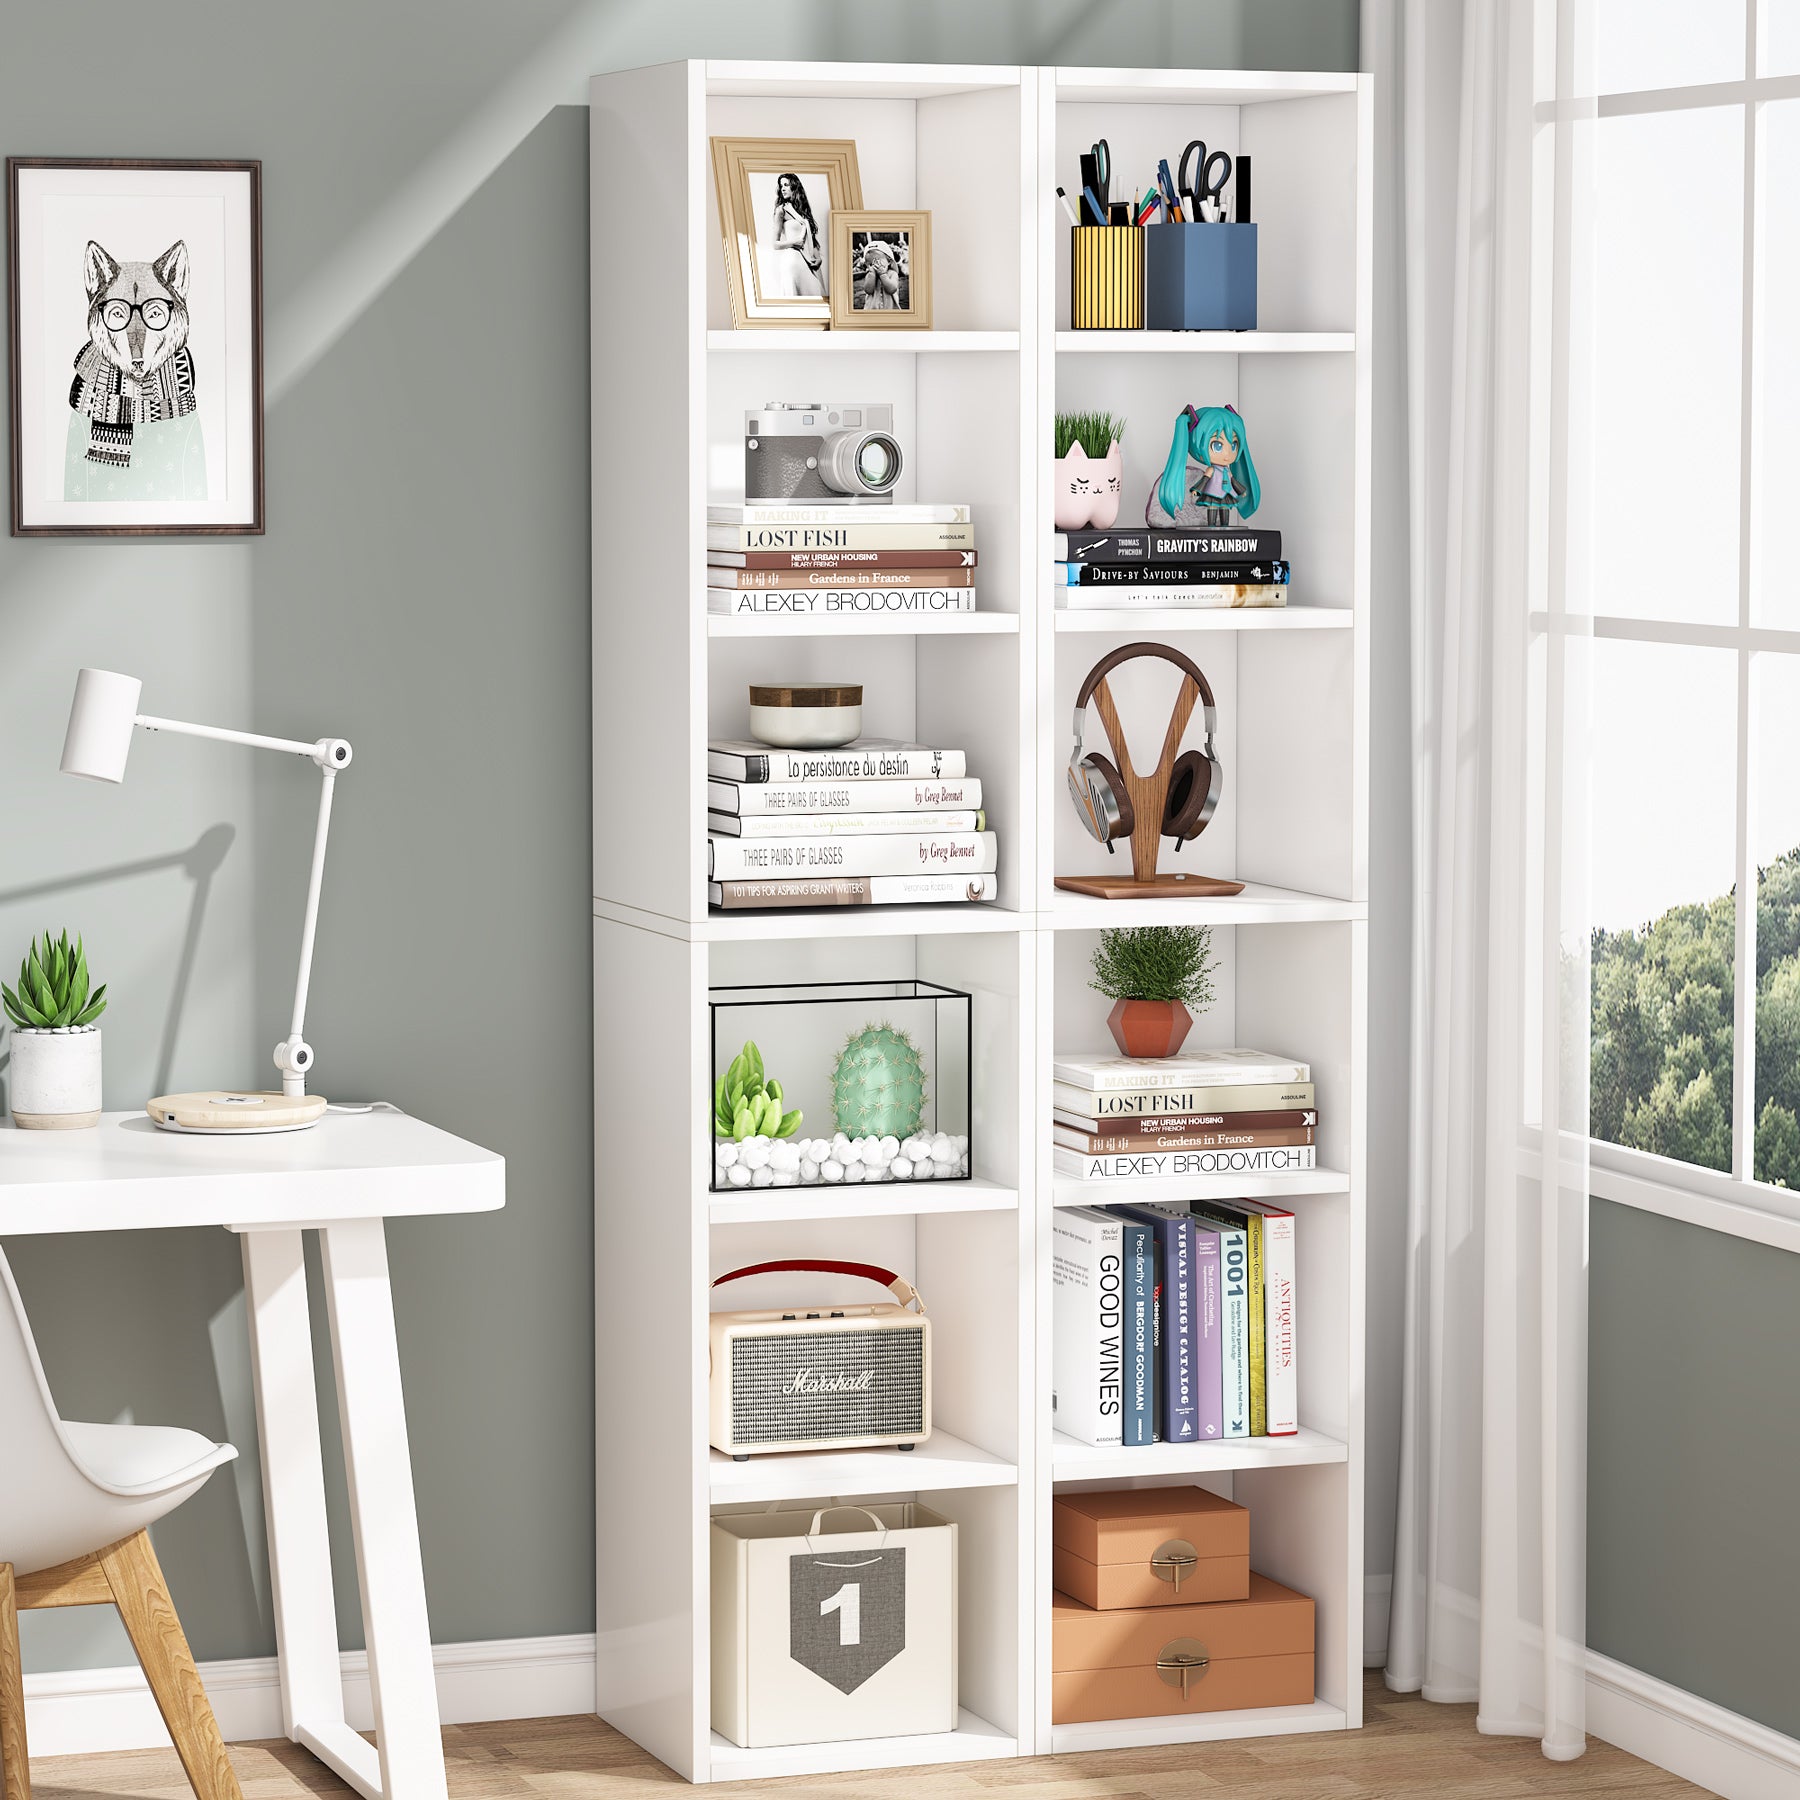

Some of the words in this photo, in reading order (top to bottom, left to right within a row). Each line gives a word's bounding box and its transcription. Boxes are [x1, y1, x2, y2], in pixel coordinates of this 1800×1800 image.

[754, 510, 810, 522] MAKING
[811, 510, 829, 521] IT
[746, 530, 798, 548] LOST
[804, 530, 848, 546] FISH
[1118, 538, 1140, 547] THOMAS
[1156, 539, 1209, 553] GRAVITY'S
[1210, 538, 1258, 552] RAINBOW
[841, 553, 878, 561] HOUSING
[1118, 548, 1143, 556] PYNCHON
[809, 574, 854, 585] Gardens
[856, 573, 870, 584] in
[872, 572, 911, 584] France
[1201, 570, 1240, 579] BENJAMIN
[738, 593, 819, 612] ALEXEY
[826, 592, 960, 611] BRODOVITCH
[788, 755, 801, 778] La
[802, 754, 860, 782] persistance
[862, 754, 877, 776] du
[878, 752, 909, 776] destin
[764, 792, 785, 808] THREE
[787, 792, 807, 808] PAIRS
[809, 792, 818, 807] OF
[820, 791, 850, 806] GLASSES
[915, 788, 924, 804] by
[924, 787, 940, 805] Greg
[942, 786, 964, 802] Bennet
[743, 849, 769, 867] THREE
[770, 848, 794, 866] PAIRS
[796, 848, 807, 866] OF
[808, 847, 843, 865] GLASSES
[919, 844, 928, 862] by
[930, 844, 948, 862] Greg
[950, 844, 976, 858] Bennet
[732, 886, 746, 898] 101
[747, 886, 761, 897] TIPS
[762, 885, 776, 896] FOR
[777, 884, 809, 896] ASPIRING
[810, 883, 834, 895] GRANT
[1104, 1075, 1159, 1088] MAKING
[1160, 1074, 1176, 1086] IT
[1098, 1096, 1148, 1114] LOST
[1152, 1094, 1194, 1112] FISH
[1140, 1119, 1160, 1128] NEW
[1160, 1118, 1188, 1126] URBAN
[1188, 1116, 1224, 1126] HOUSING
[1157, 1136, 1202, 1148] Gardens
[1202, 1135, 1216, 1146] in
[1218, 1134, 1254, 1145] France
[1090, 1156, 1168, 1177] ALEXEY
[1173, 1150, 1301, 1173] BRODOVITCH
[1135, 1234, 1145, 1284] Peculiarity
[1178, 1223, 1186, 1278] VISUAL
[1227, 1234, 1244, 1297] 1001
[1100, 1255, 1120, 1328] GOOD
[1136, 1286, 1145, 1297] of
[1179, 1283, 1188, 1334] DESIGN
[1135, 1301, 1144, 1352] BERGDORF
[1278, 1278, 1291, 1368] ANTIQUITIES
[783, 1368, 874, 1394] Marshall
[1100, 1336, 1120, 1416] WINES
[1180, 1338, 1189, 1404] CATALOG
[1135, 1355, 1144, 1411] GOODMAN
[820, 1582, 860, 1646] 1
